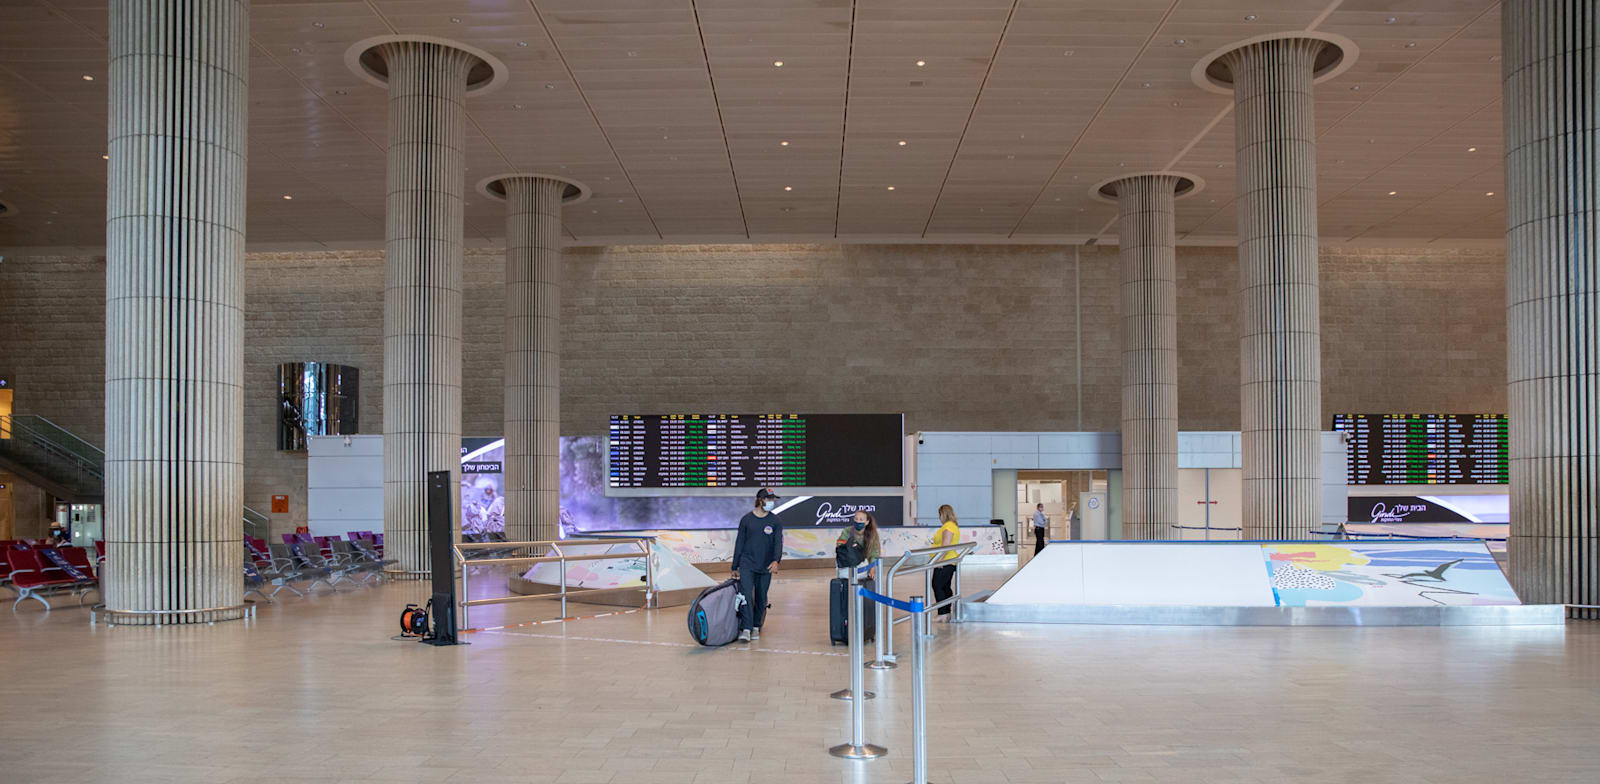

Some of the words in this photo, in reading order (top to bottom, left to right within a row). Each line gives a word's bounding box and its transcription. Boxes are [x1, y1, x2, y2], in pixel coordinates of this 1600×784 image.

[462, 464, 476, 472] שלך
[841, 503, 857, 514] שלך
[1394, 503, 1409, 514] שלך
[1410, 504, 1427, 512] הבית
